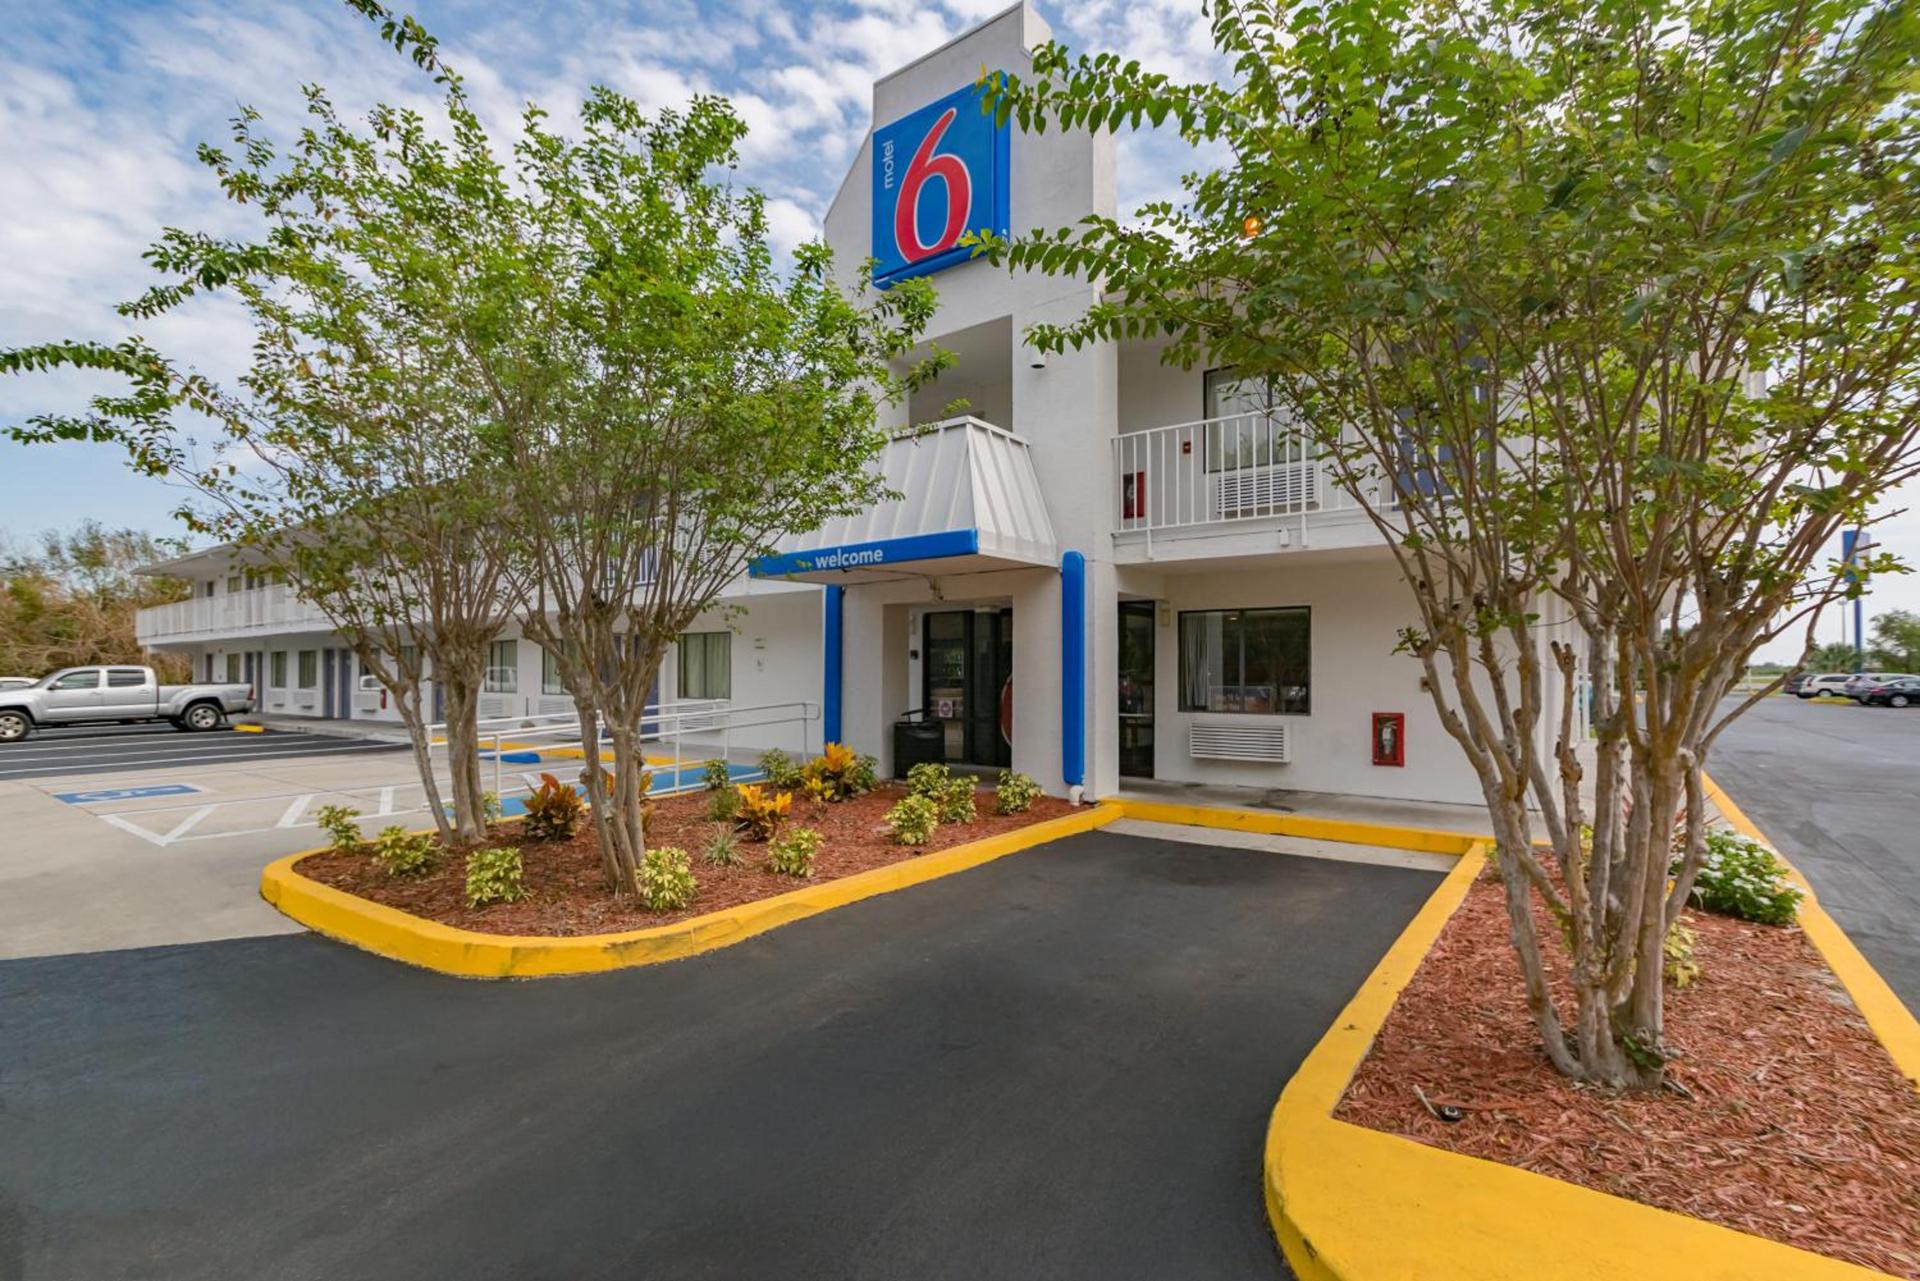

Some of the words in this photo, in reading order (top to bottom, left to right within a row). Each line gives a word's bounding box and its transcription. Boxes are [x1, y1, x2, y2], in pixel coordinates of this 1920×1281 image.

[882, 139, 894, 189] motel
[894, 107, 972, 264] 6
[815, 548, 884, 569] welcome
